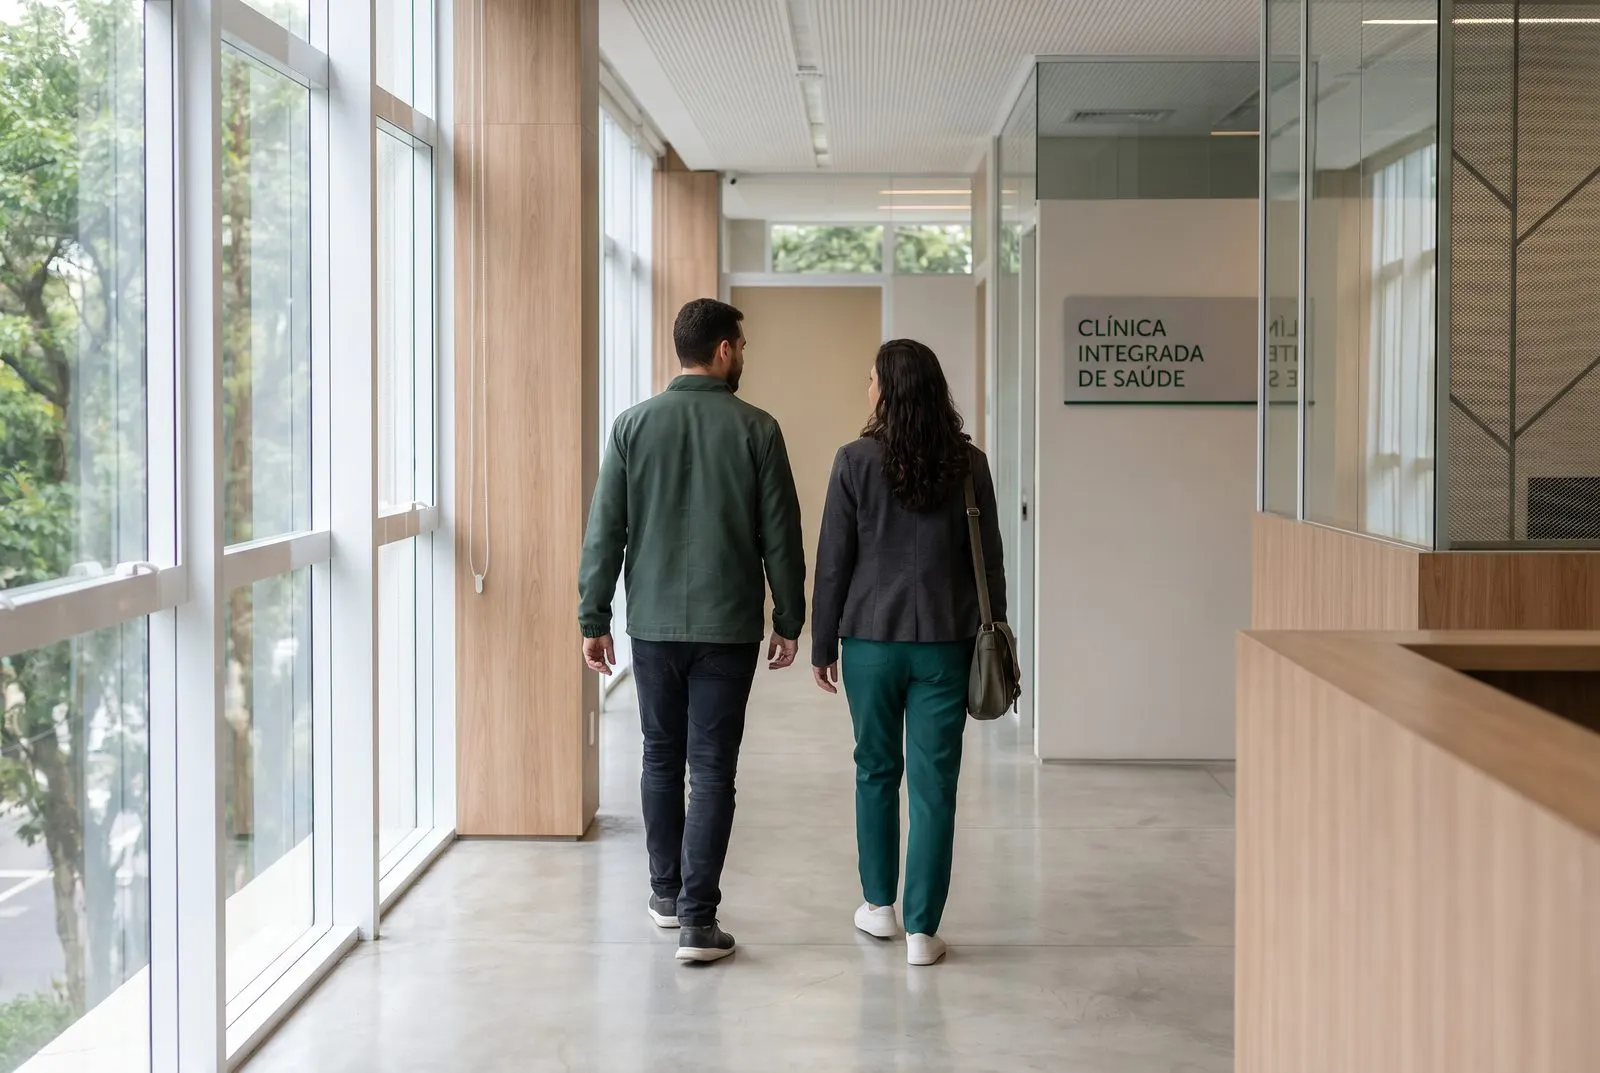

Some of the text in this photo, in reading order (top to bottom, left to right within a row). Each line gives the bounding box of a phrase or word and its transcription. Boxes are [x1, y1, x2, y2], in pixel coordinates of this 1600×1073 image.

[1078, 315, 1167, 337] CLÍNICA
[1078, 345, 1205, 362] INTEGRADA
[1078, 365, 1185, 387] DE SAÚDE
